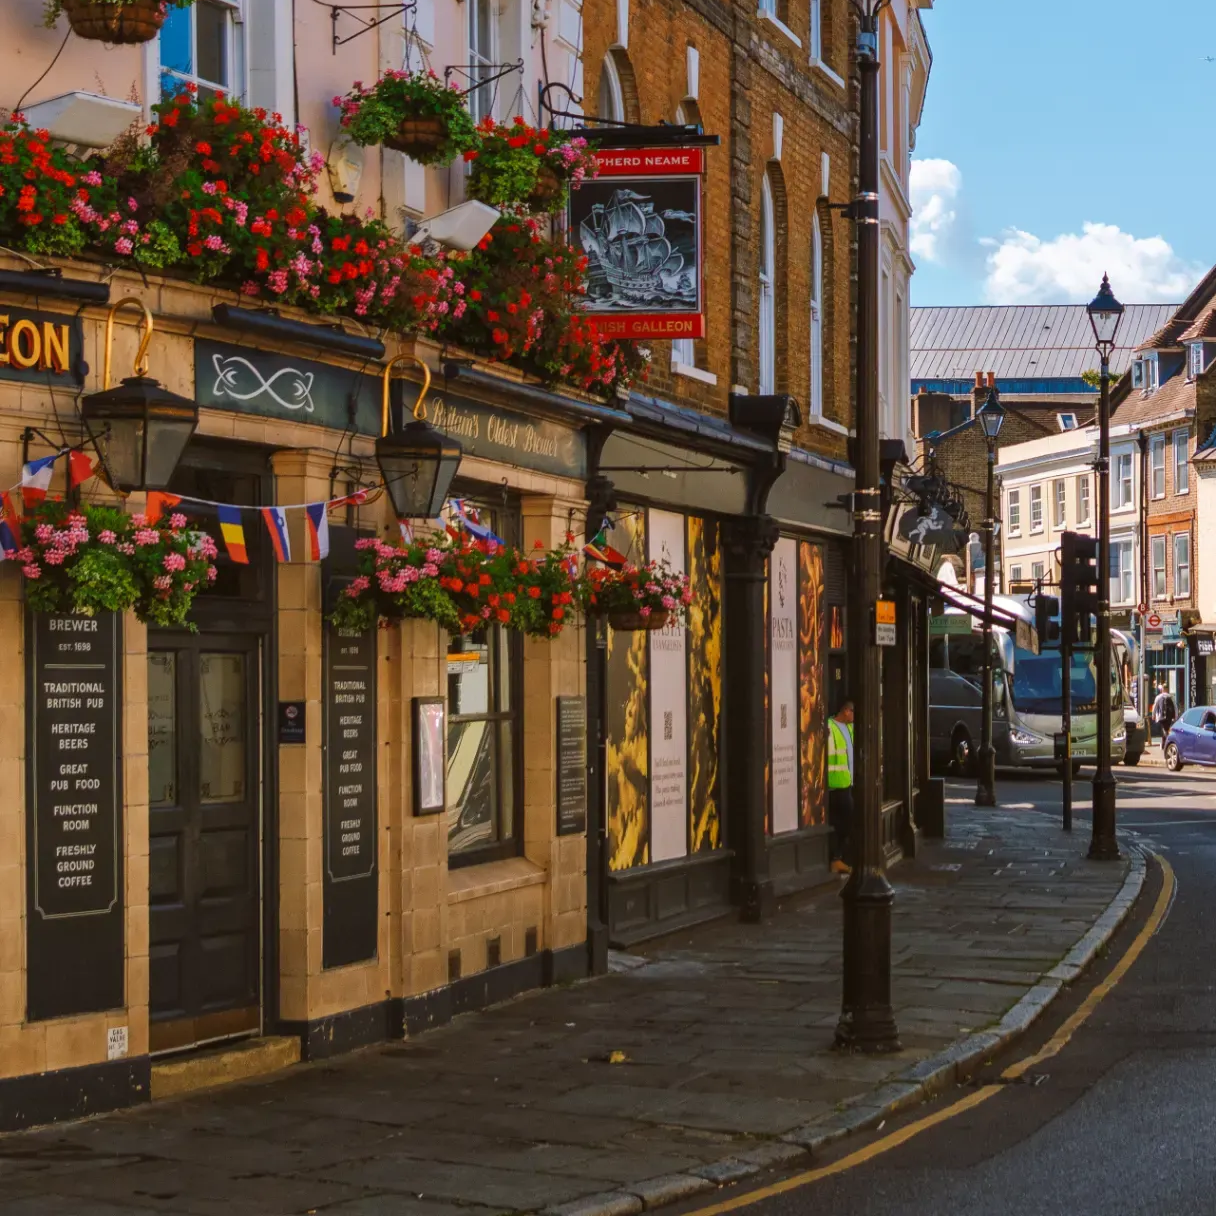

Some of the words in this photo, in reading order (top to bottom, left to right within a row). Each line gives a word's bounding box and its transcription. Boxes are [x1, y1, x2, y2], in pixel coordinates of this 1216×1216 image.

[597, 158, 640, 166] PHERD
[645, 156, 689, 165] NEAME
[632, 320, 693, 332] GALLEON
[432, 397, 479, 439] Britain's
[487, 413, 519, 449] Oldest
[523, 424, 559, 457] Brewer
[49, 619, 98, 632] BREWER
[58, 643, 73, 651] EST.
[74, 642, 91, 651] 1698
[44, 683, 105, 693] TRADITIONAL
[46, 698, 82, 709] BRITISH
[86, 698, 104, 708] PUB
[339, 715, 363, 725] HERITAGE
[51, 723, 96, 734] HERITAGE
[58, 738, 89, 750] BEERS
[342, 750, 358, 760] GREAT
[59, 764, 88, 775] GREAT
[339, 764, 349, 773] PUB
[350, 763, 363, 772] FOOD
[51, 780, 69, 790] PUB
[75, 779, 101, 790] FOOD
[338, 784, 363, 795] FUNCTION
[343, 798, 358, 808] ROOM
[54, 804, 98, 816] FUNCTION
[63, 820, 90, 831] ROOM
[340, 818, 361, 830] FRESHLY
[341, 832, 361, 843] GROUND
[56, 844, 97, 857] FRESHLY
[342, 845, 360, 856] COFFEE
[57, 860, 95, 872] GROUND
[58, 875, 92, 888] COFFEE
